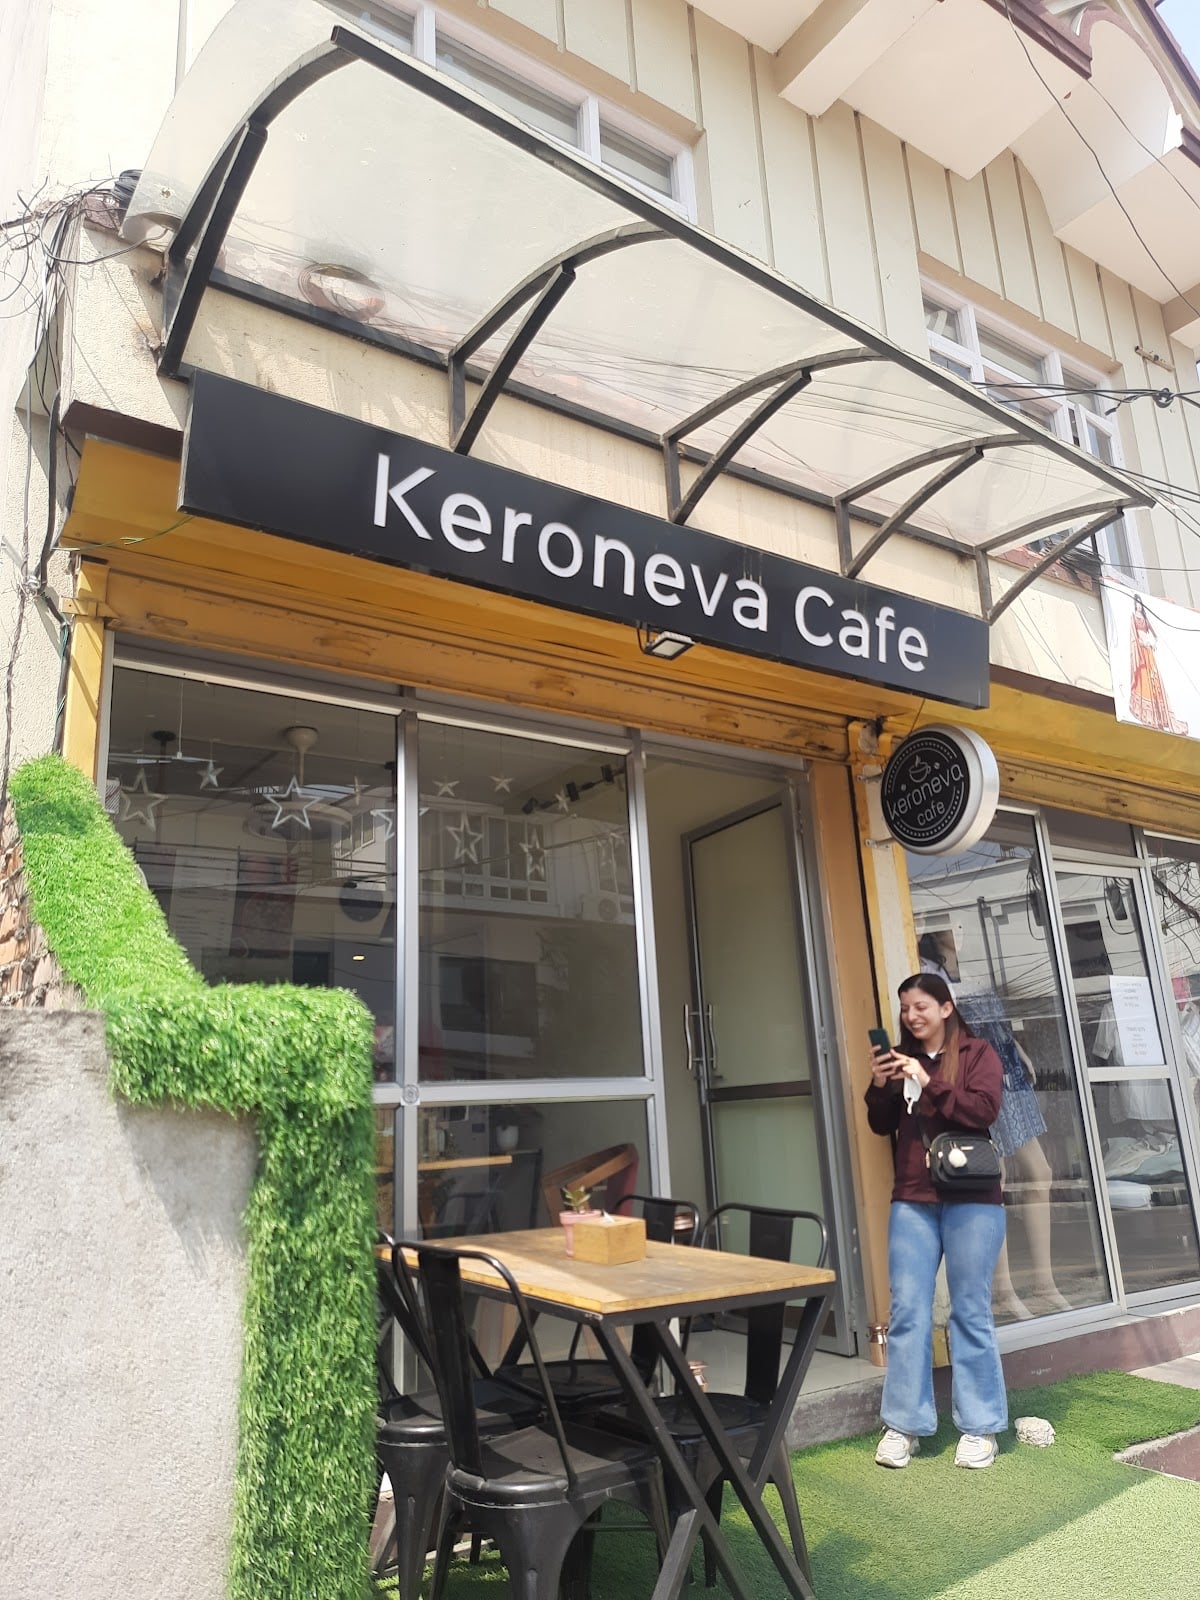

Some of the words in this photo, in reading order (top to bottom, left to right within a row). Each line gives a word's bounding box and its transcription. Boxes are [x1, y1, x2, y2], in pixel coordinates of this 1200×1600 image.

[372, 453, 768, 631] Keroneva
[795, 586, 929, 671] Cafe
[886, 763, 964, 820] keroneva
[916, 800, 946, 826] cafe
